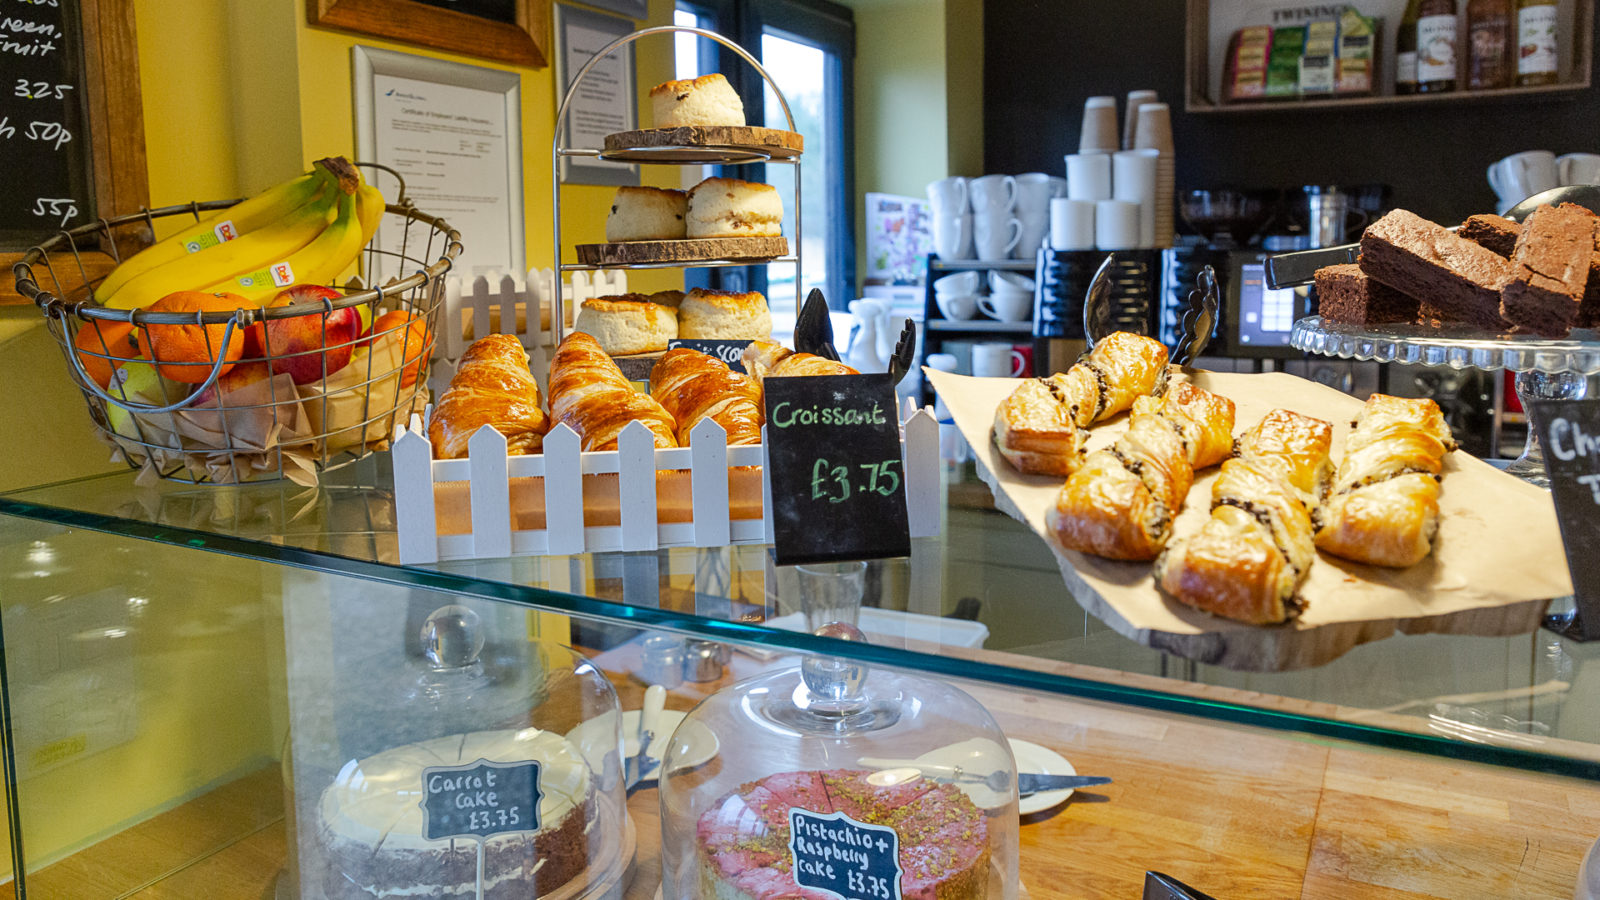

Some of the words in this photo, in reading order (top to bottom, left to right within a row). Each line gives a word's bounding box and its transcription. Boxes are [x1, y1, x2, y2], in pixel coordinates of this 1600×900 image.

[0, 12, 62, 39] reen,
[25, 121, 72, 151] 50p
[33, 198, 78, 228] 55p
[773, 402, 886, 428] Croissant
[812, 458, 901, 503] £3.75
[429, 770, 497, 794] Carrot
[469, 806, 520, 831] £3.75
[796, 836, 869, 871] Raspberry
[847, 869, 890, 900] £3.75
